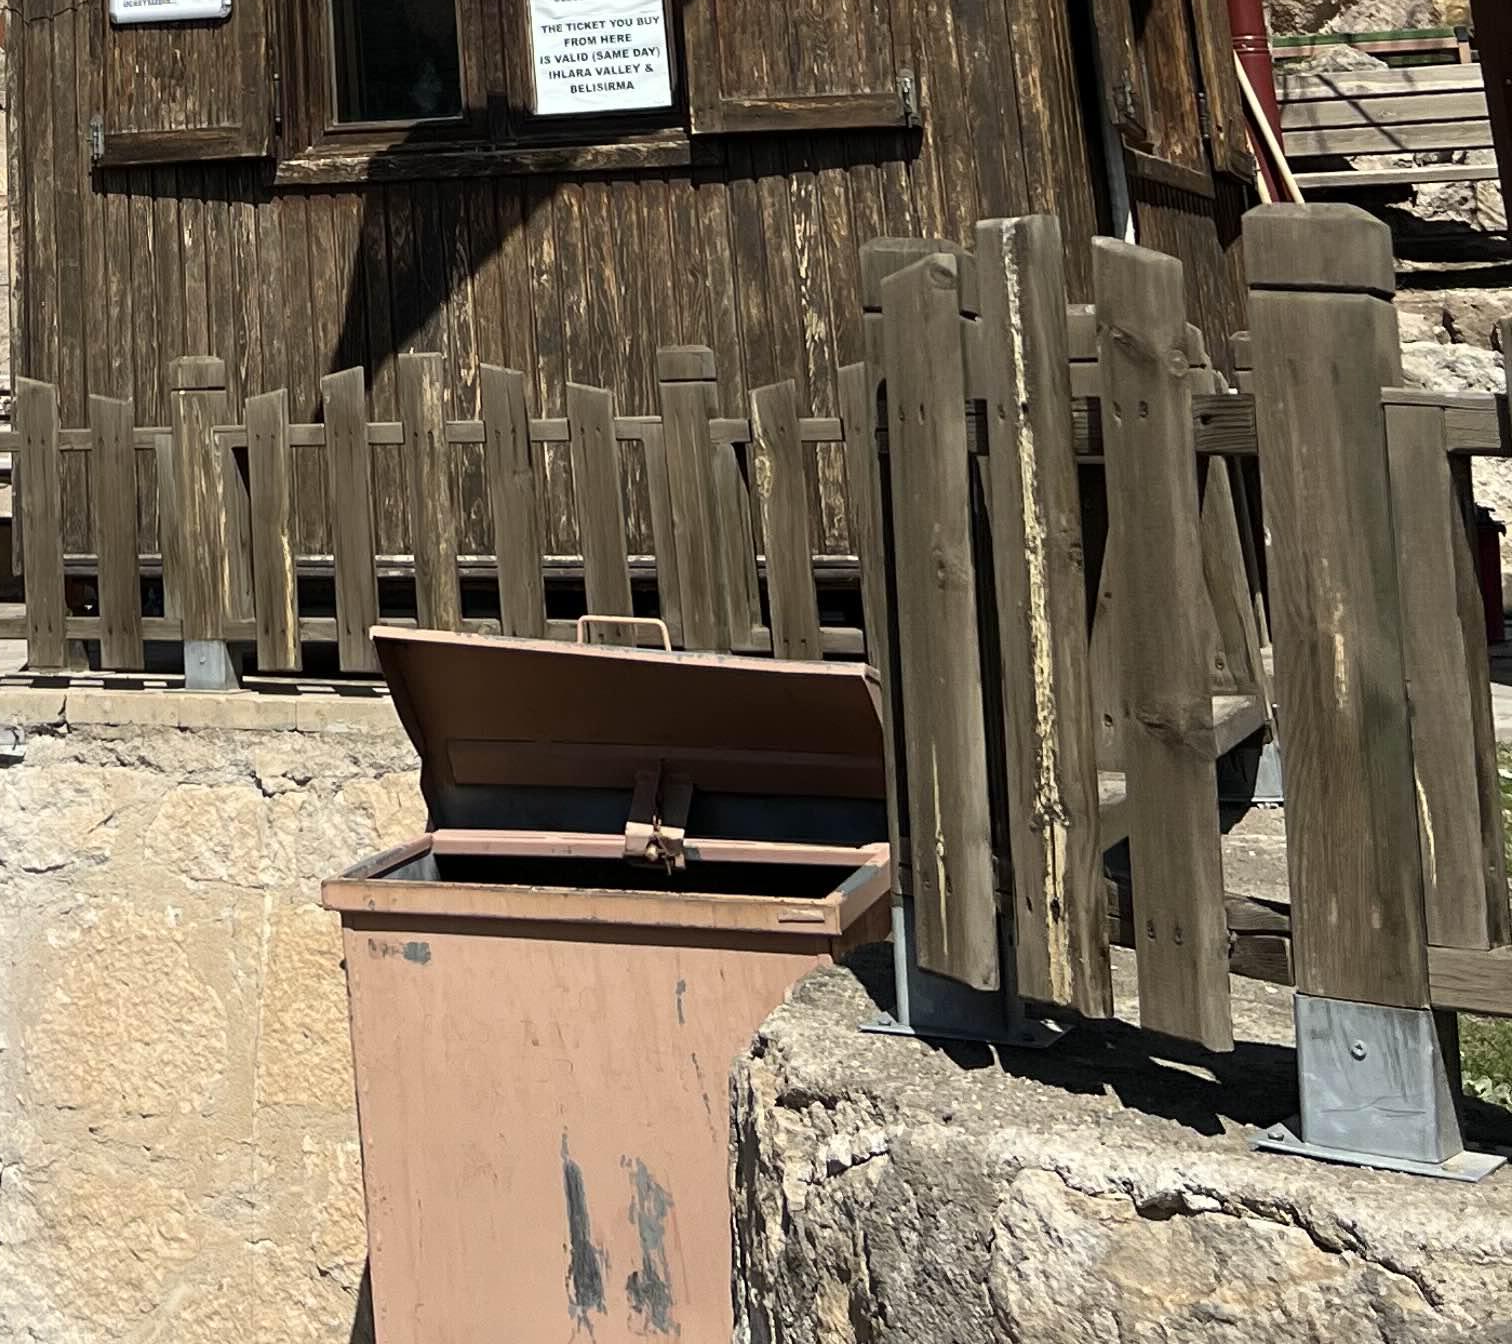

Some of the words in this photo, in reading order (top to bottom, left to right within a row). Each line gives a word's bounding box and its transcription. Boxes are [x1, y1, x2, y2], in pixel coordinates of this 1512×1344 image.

[541, 24, 562, 34] THE
[566, 20, 606, 32] TICKET
[609, 18, 633, 28] YOU
[636, 16, 660, 26] BUY
[563, 36, 597, 47] FROM
[600, 33, 632, 44] HERE
[539, 55, 551, 65] IS
[554, 52, 589, 64] VALID
[592, 48, 630, 62] (SAME
[632, 46, 660, 59] DAY)
[548, 68, 592, 80] IHLARA
[595, 63, 641, 76] VALLEY
[644, 63, 654, 73] &
